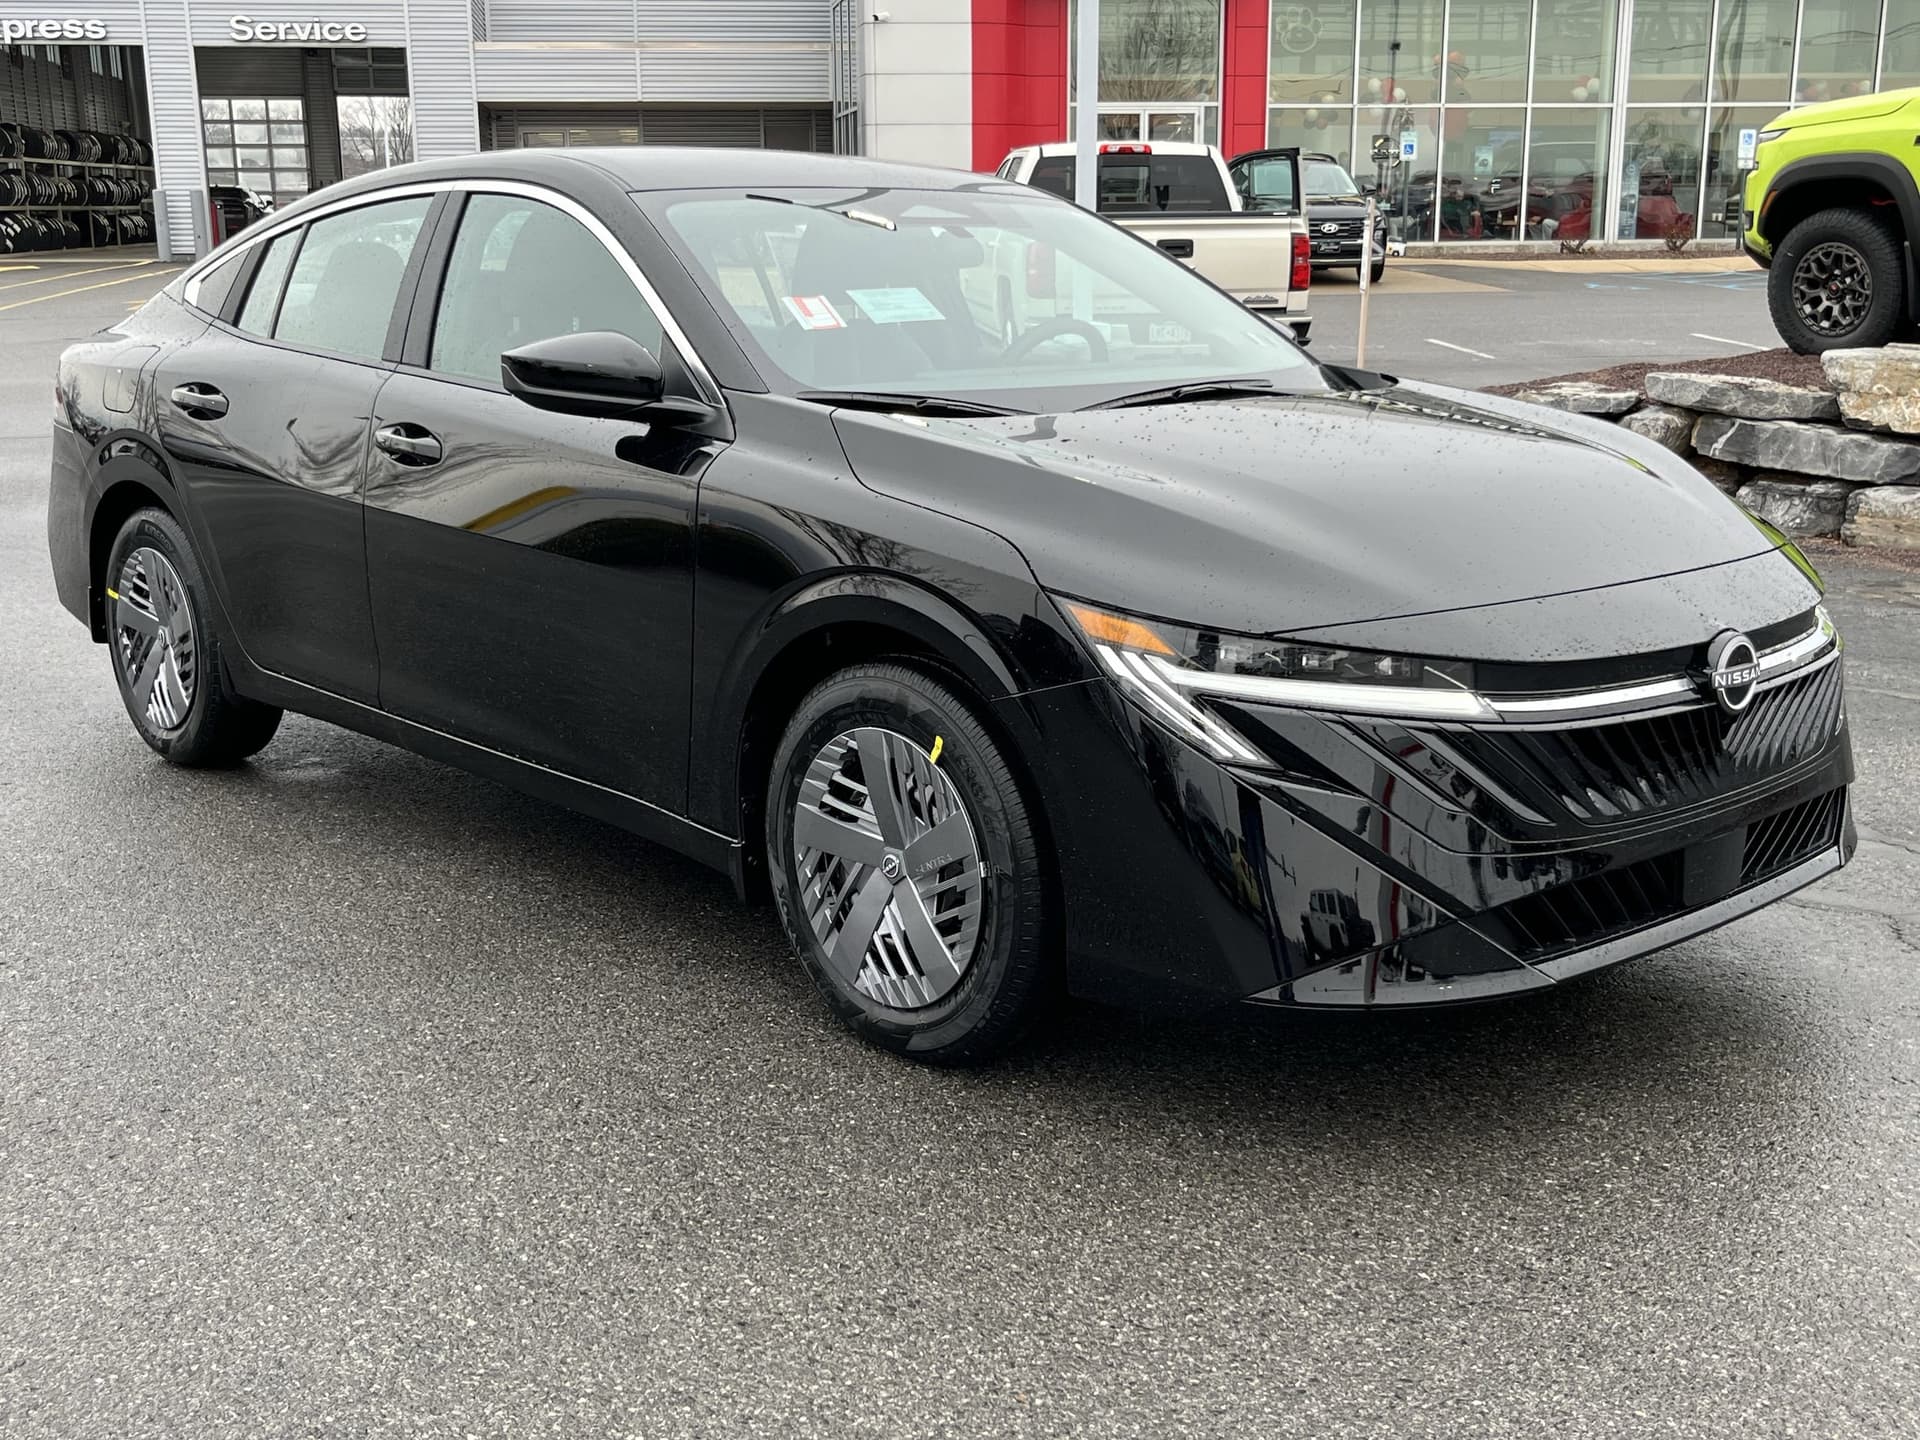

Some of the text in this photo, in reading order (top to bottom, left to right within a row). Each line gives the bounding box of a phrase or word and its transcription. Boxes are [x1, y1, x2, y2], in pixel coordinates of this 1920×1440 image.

[0, 19, 107, 44] press
[230, 15, 367, 41] Service
[1714, 666, 1761, 687] NISSAN
